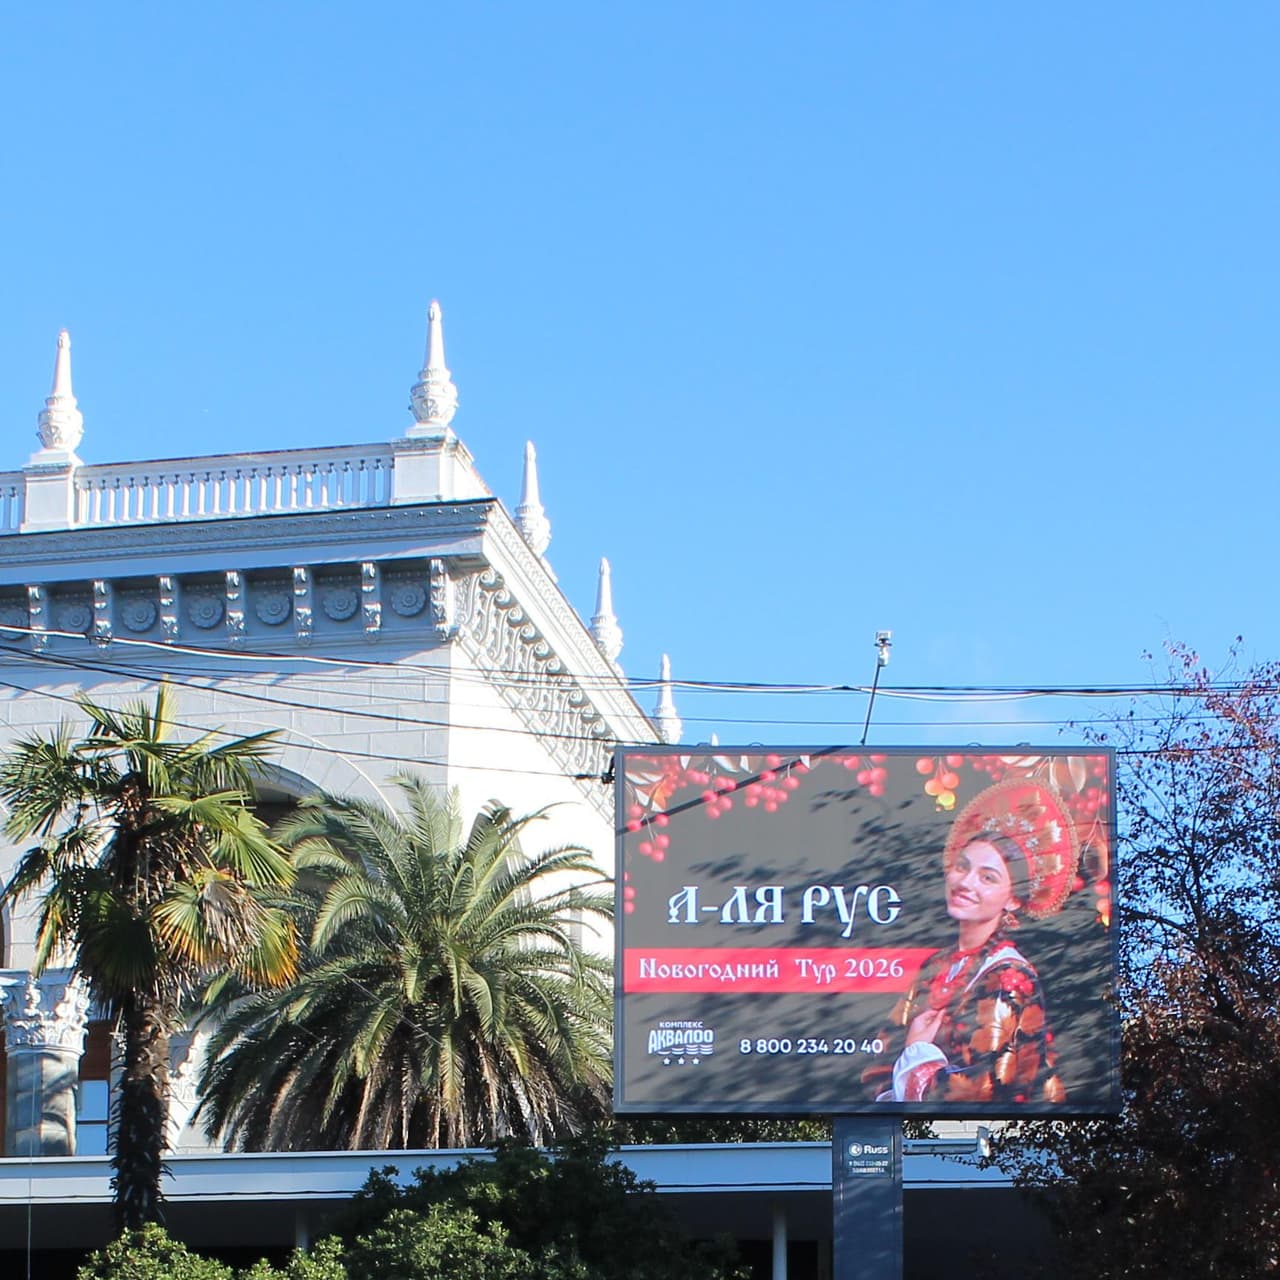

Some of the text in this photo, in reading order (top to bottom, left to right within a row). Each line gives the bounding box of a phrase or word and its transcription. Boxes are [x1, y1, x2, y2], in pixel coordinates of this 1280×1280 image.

[638, 957, 905, 984] Новогодний Тур 2026
[658, 1021, 704, 1029] КОМПЛЕКС
[648, 1030, 714, 1054] АКВАЛОО
[740, 1039, 884, 1054] 8 800 234 20 40
